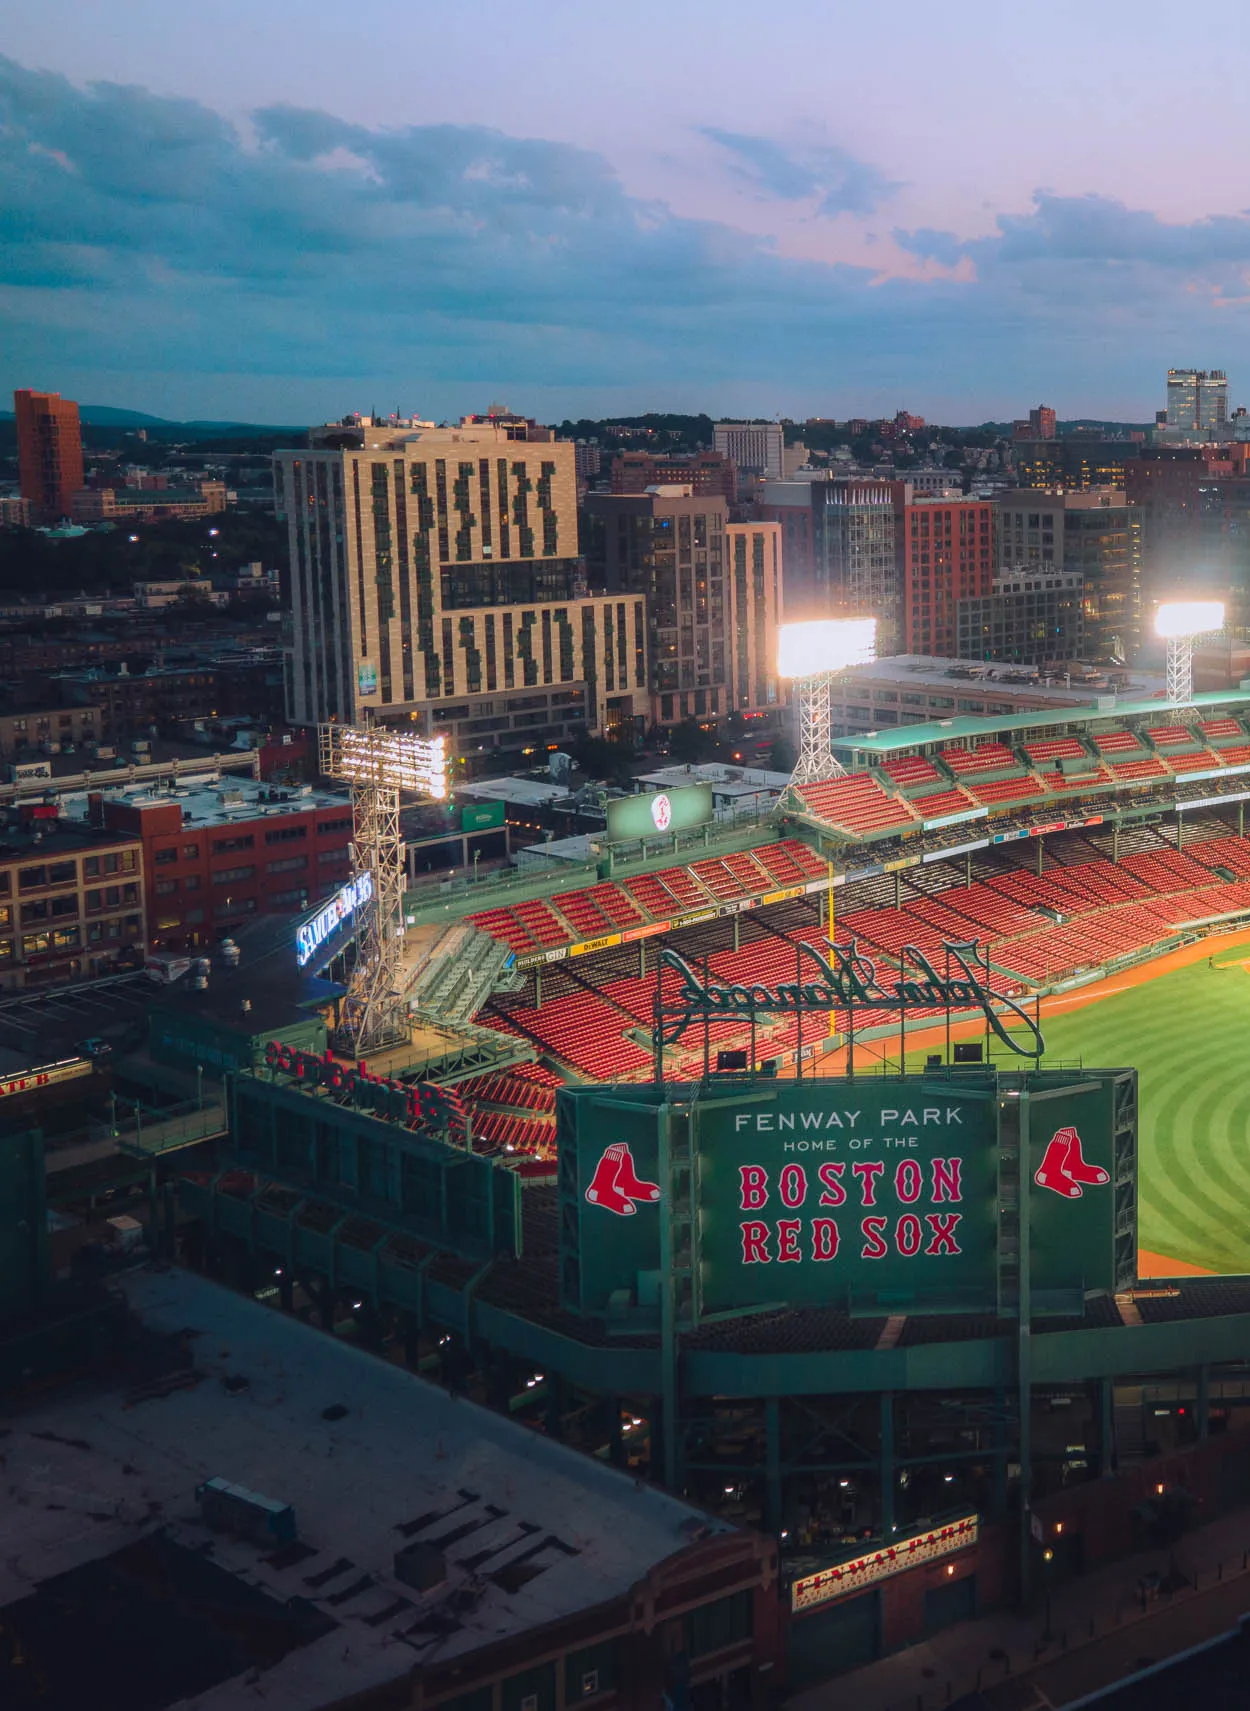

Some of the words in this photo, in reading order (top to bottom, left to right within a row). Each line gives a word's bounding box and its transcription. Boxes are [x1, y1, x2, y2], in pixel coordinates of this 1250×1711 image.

[297, 900, 340, 966] SAMUEL
[36, 1073, 49, 1087] B
[736, 1110, 861, 1131] FENWAY
[881, 1107, 963, 1127] PARK
[784, 1139, 837, 1152] HOME
[849, 1138, 873, 1150] OF
[883, 1137, 919, 1148] THE
[738, 1157, 963, 1211] BOSTON
[740, 1217, 842, 1264] RED
[861, 1213, 963, 1260] SOX
[797, 1546, 900, 1596] FENWAY
[909, 1518, 974, 1554] PARK
